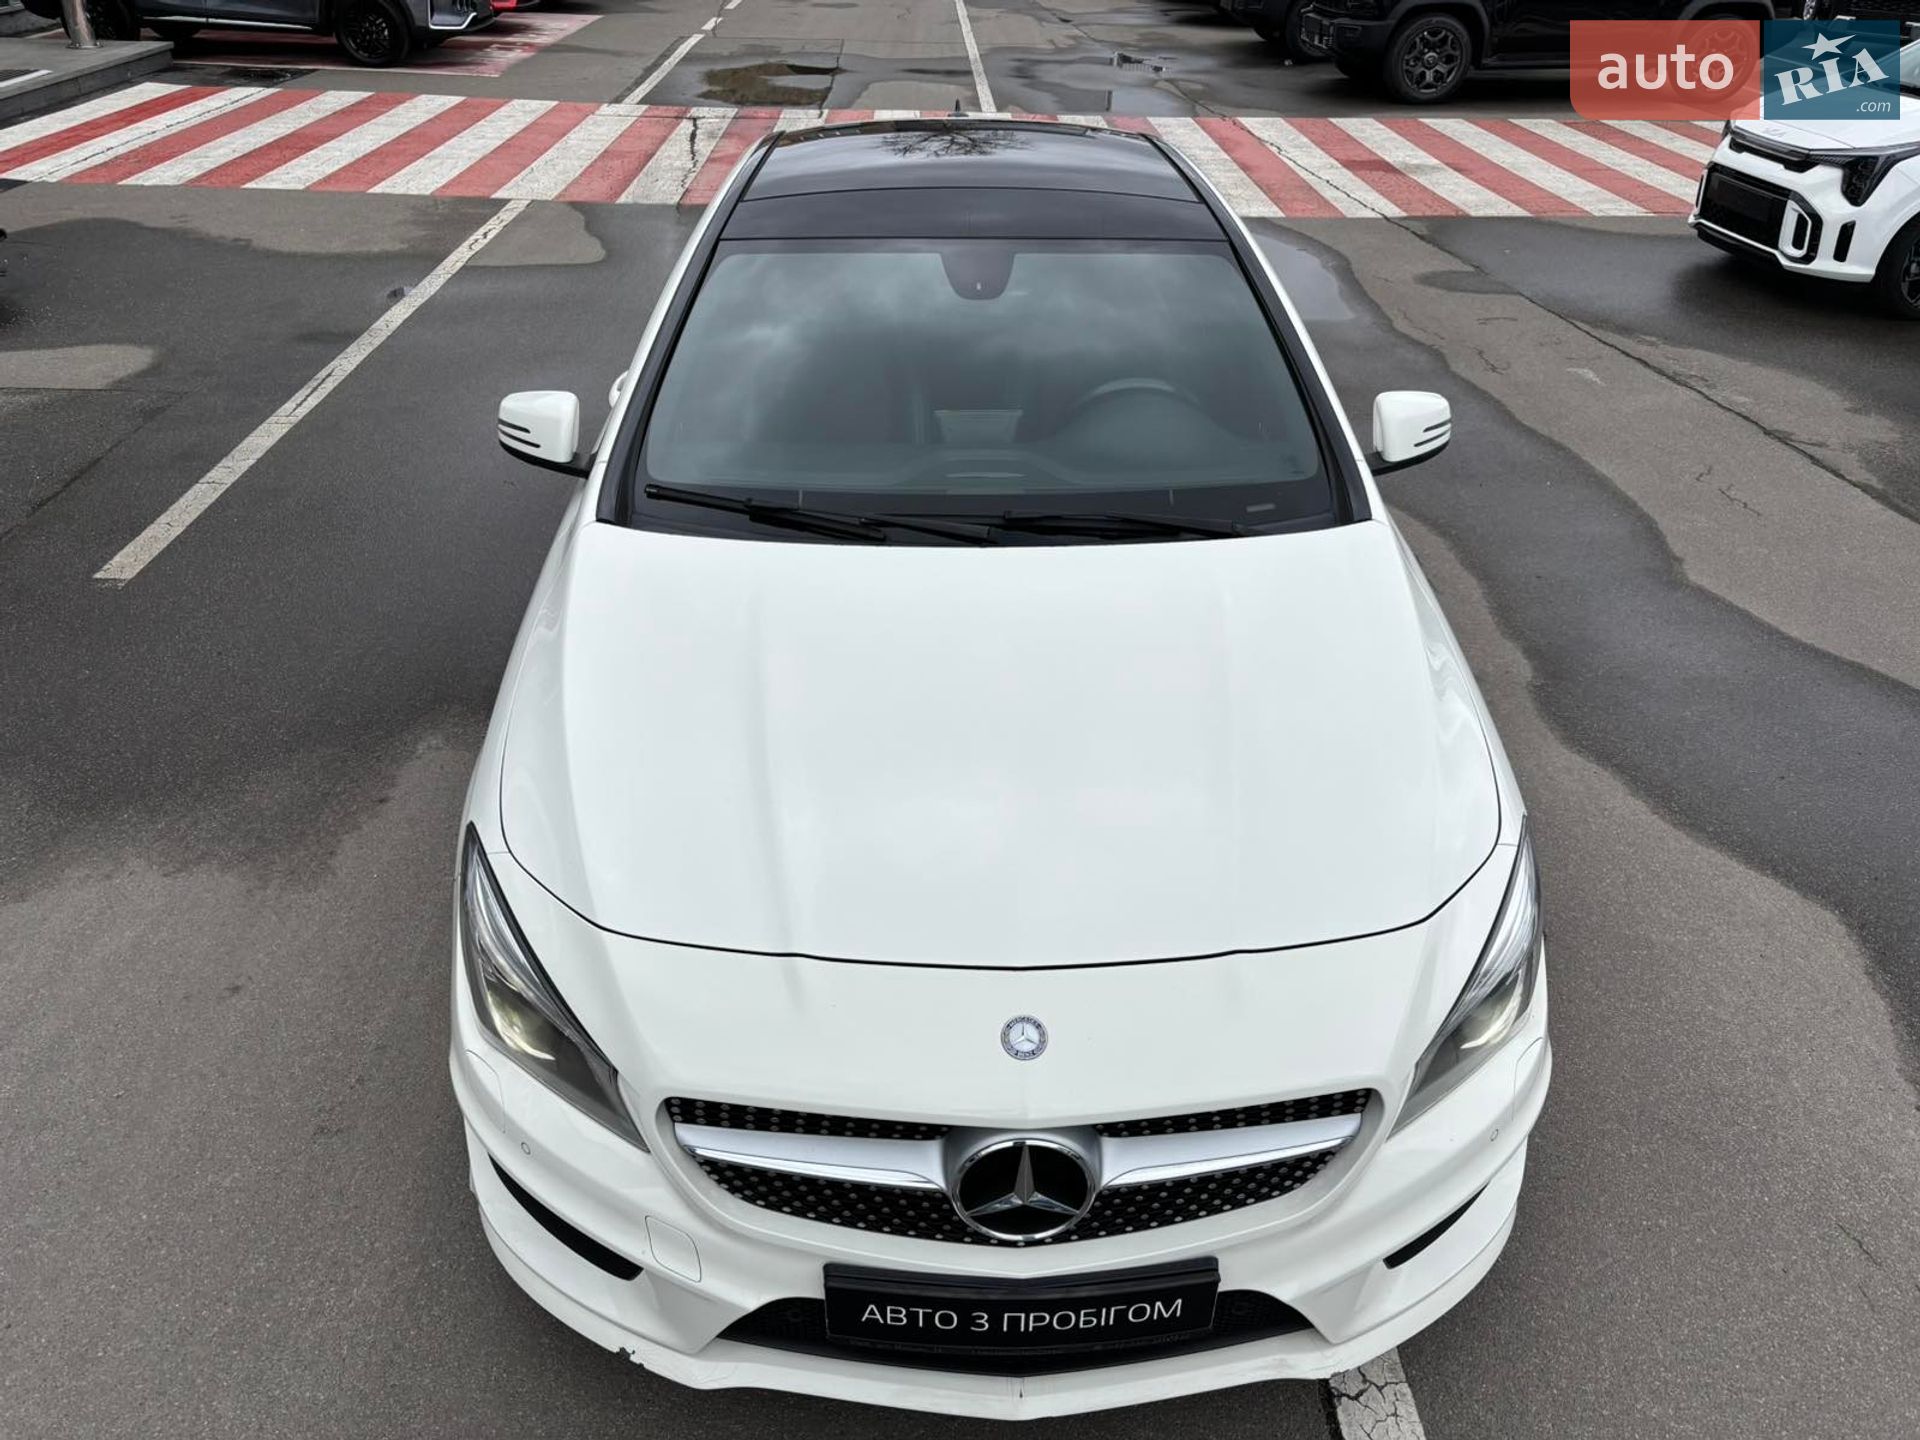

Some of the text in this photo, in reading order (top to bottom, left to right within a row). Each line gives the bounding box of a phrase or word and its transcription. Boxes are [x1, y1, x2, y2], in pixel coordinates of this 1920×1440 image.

[861, 1298, 1183, 1333] АВТО З ПРОБІГОМ
